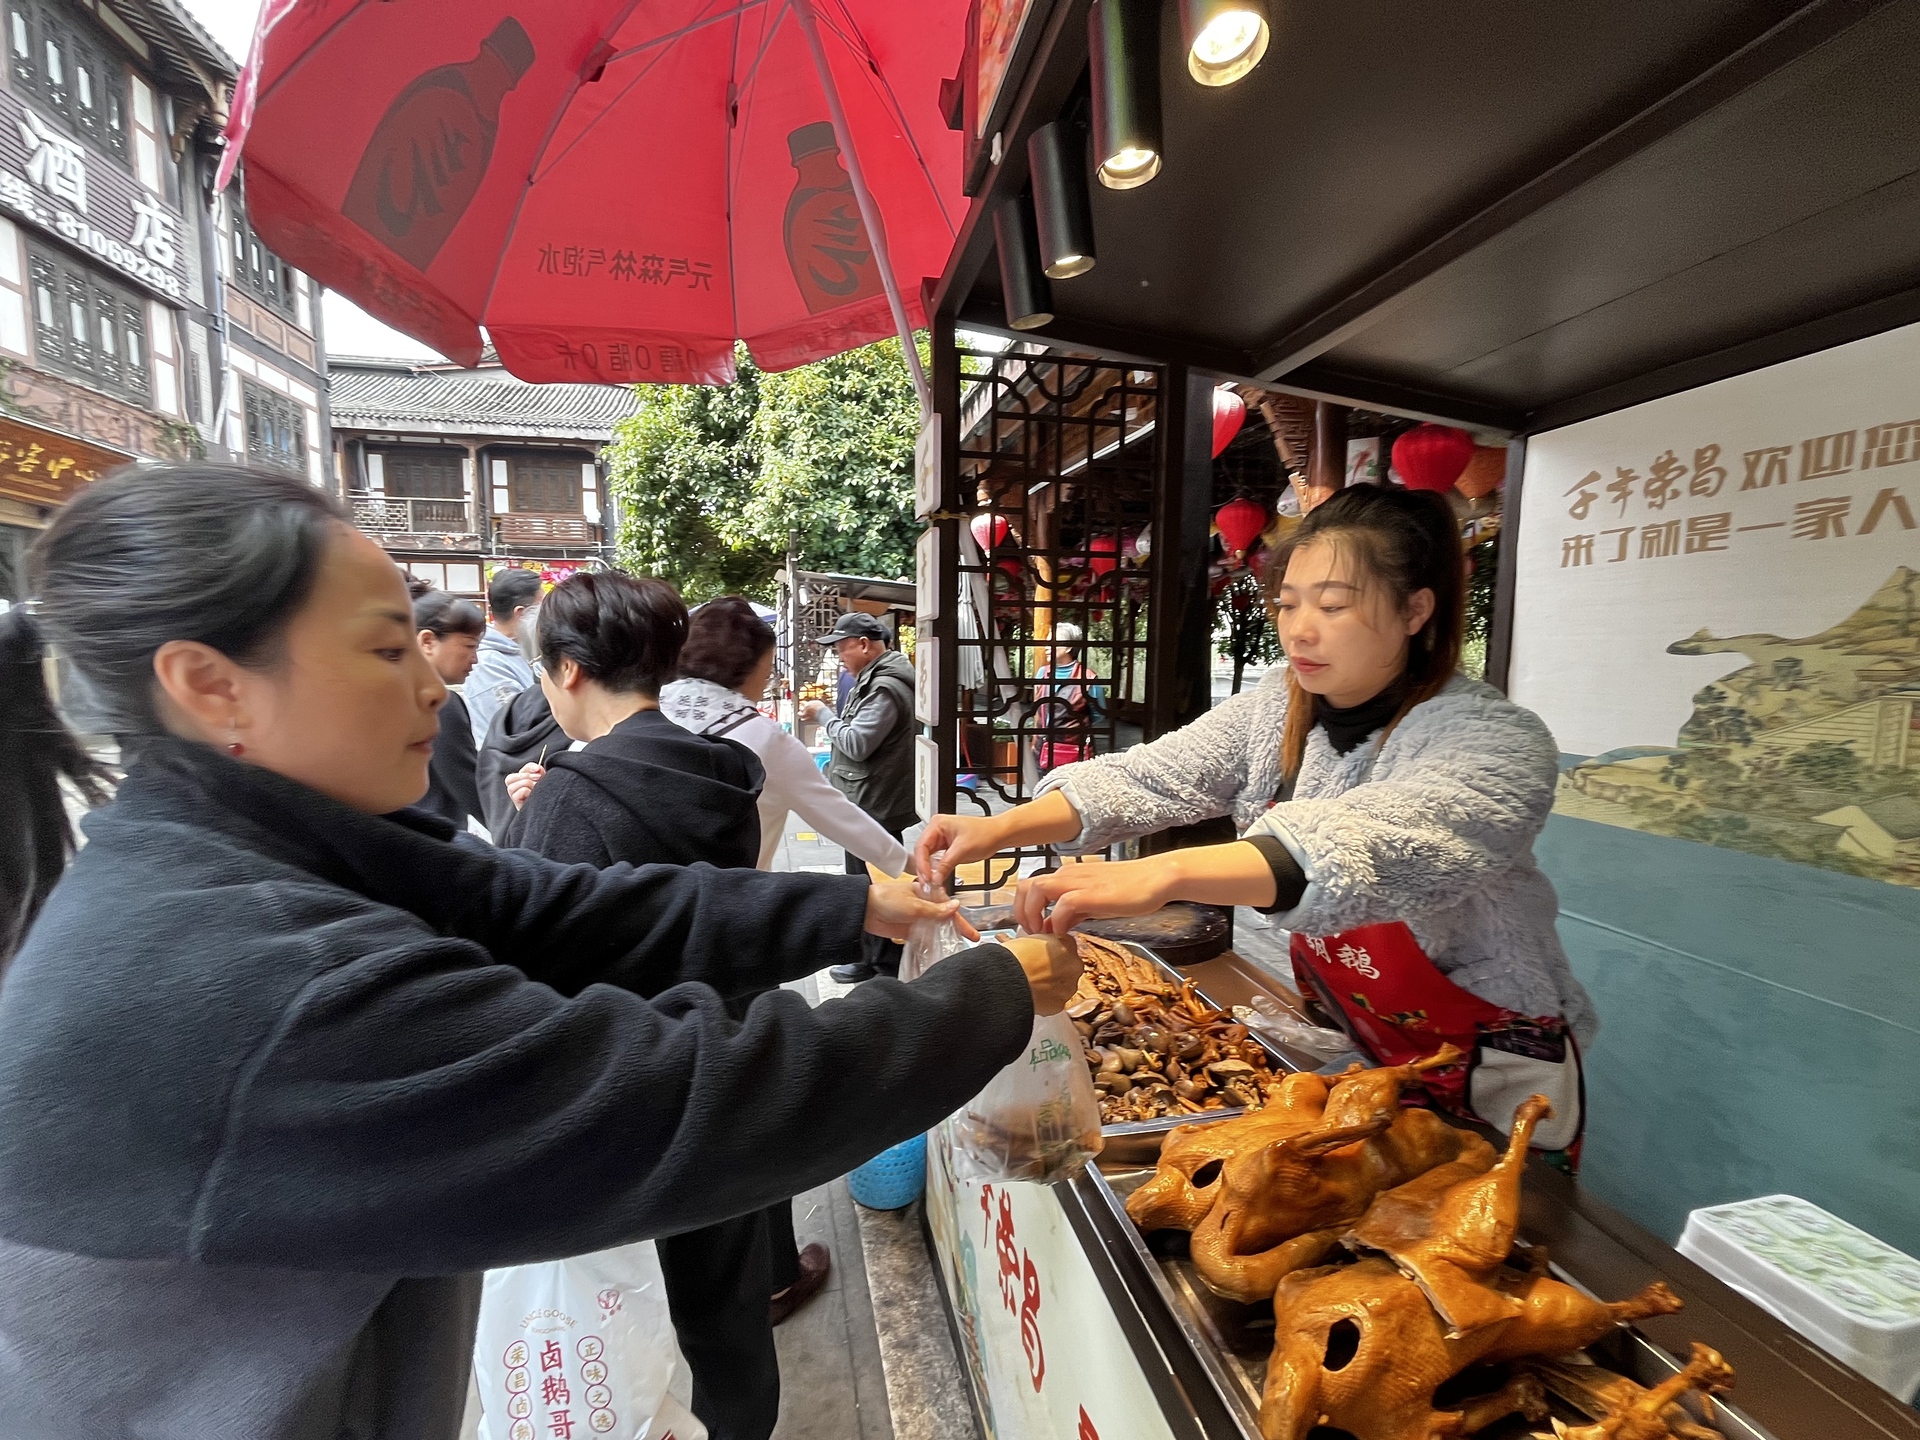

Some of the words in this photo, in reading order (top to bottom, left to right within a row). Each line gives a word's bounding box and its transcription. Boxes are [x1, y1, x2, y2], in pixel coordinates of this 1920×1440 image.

[15, 107, 177, 269] 酒店
[1560, 487, 1918, 569] 来了就是一家人
[544, 1309, 578, 1329] GOOSE
[540, 1339, 576, 1440] 卤鹅哥
